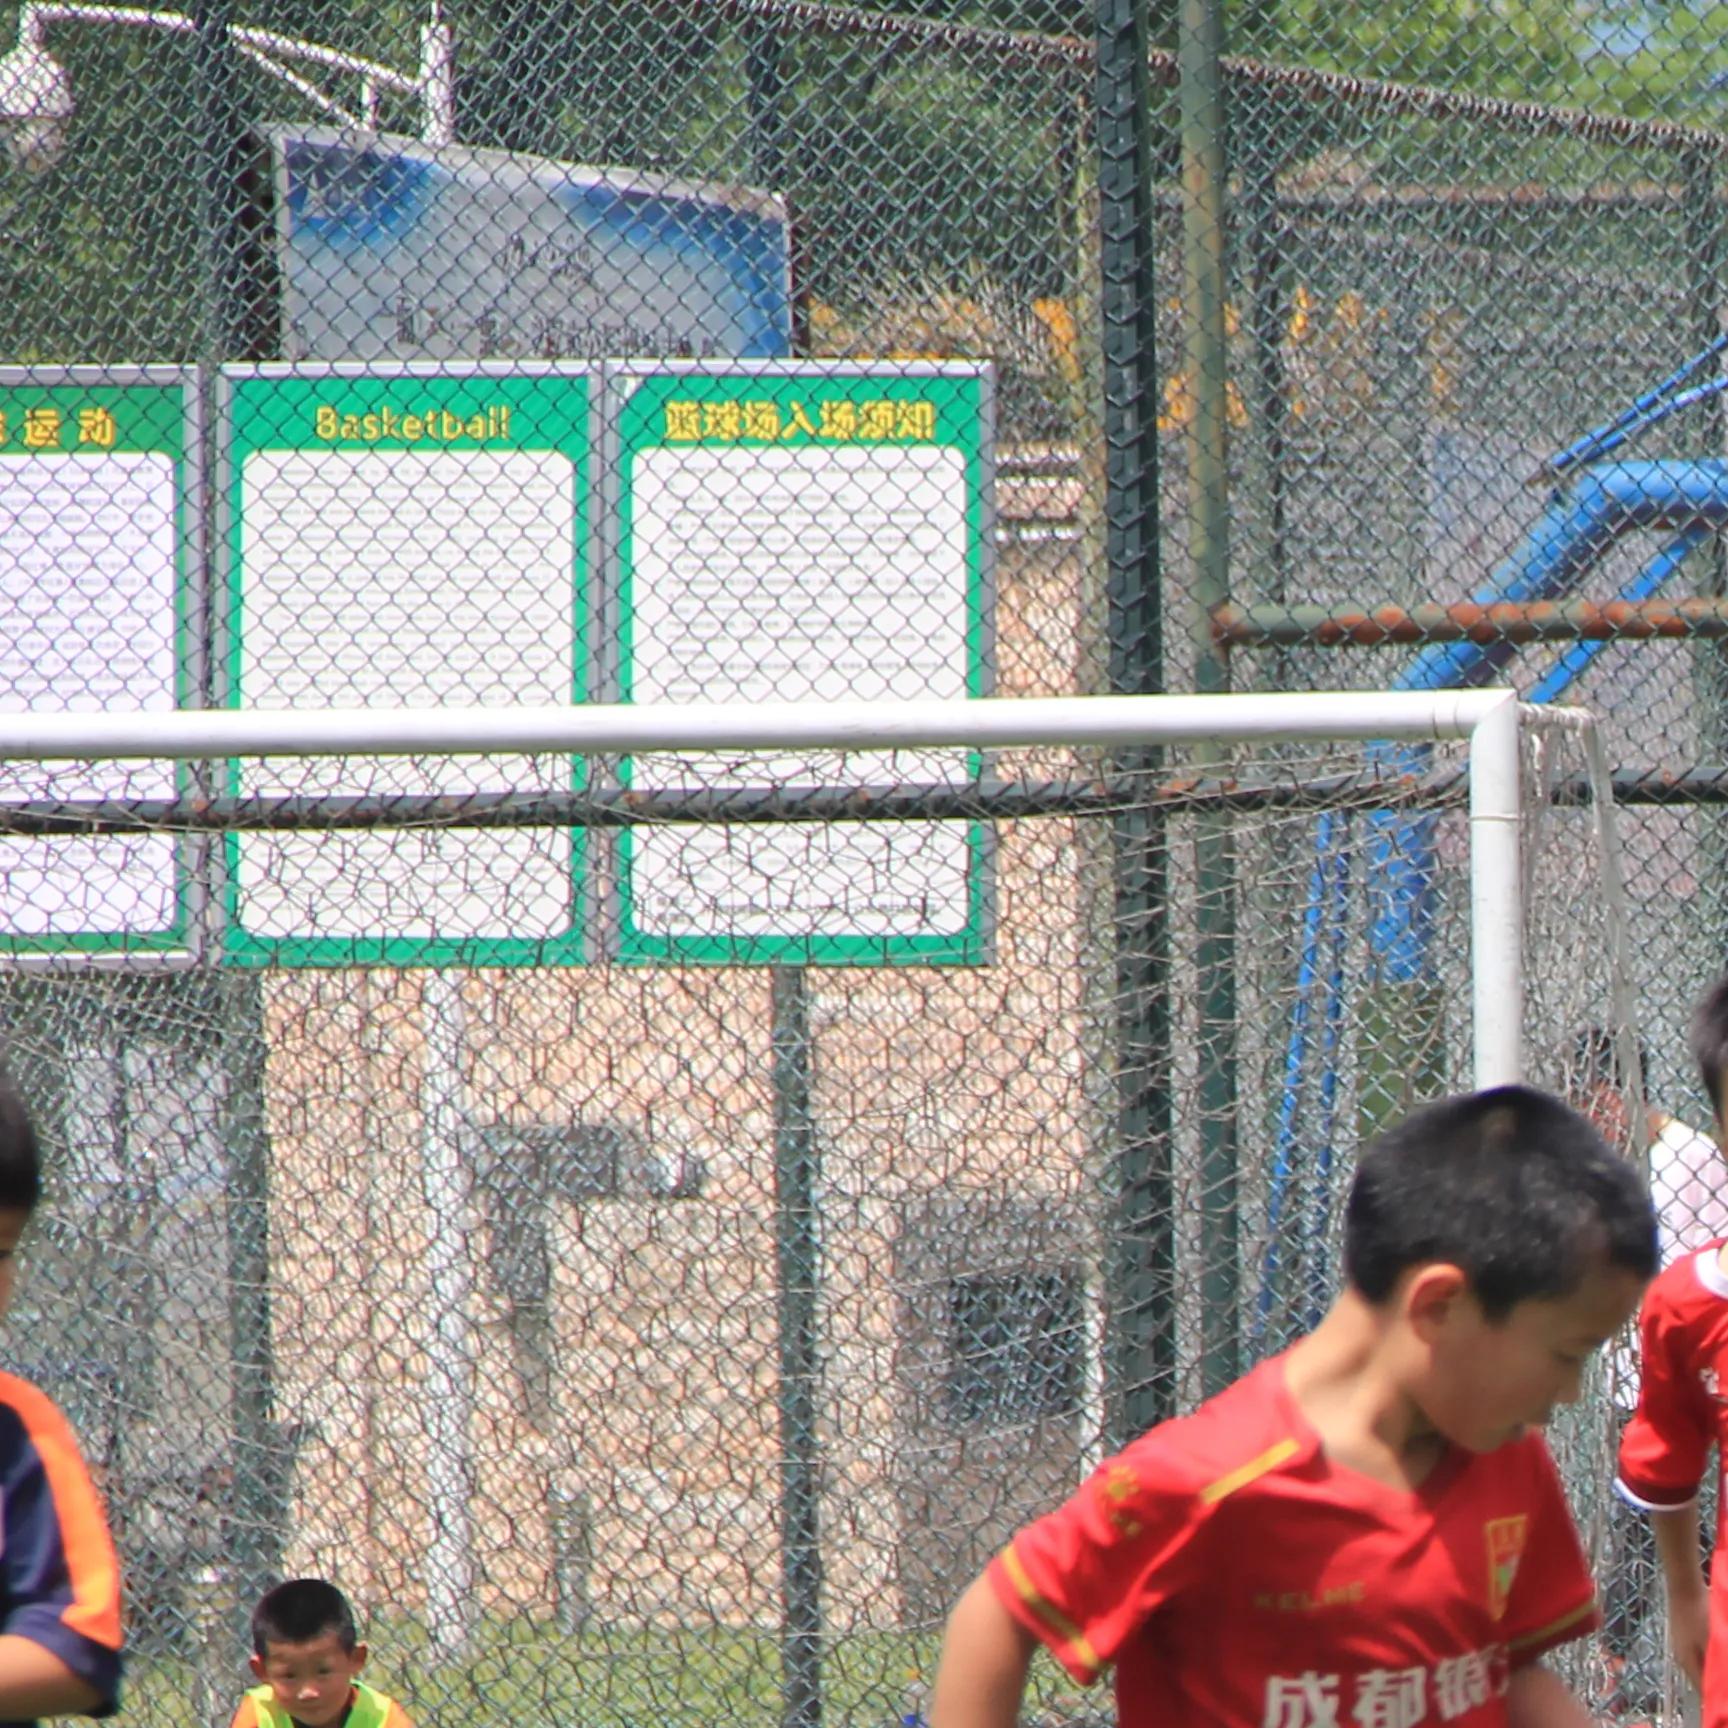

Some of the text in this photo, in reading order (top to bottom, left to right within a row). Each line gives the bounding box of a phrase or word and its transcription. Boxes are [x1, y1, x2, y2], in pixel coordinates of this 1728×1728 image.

[0, 407, 116, 447] 运动
[315, 404, 511, 440] Basketball
[665, 399, 934, 440] 篮球场入场须知
